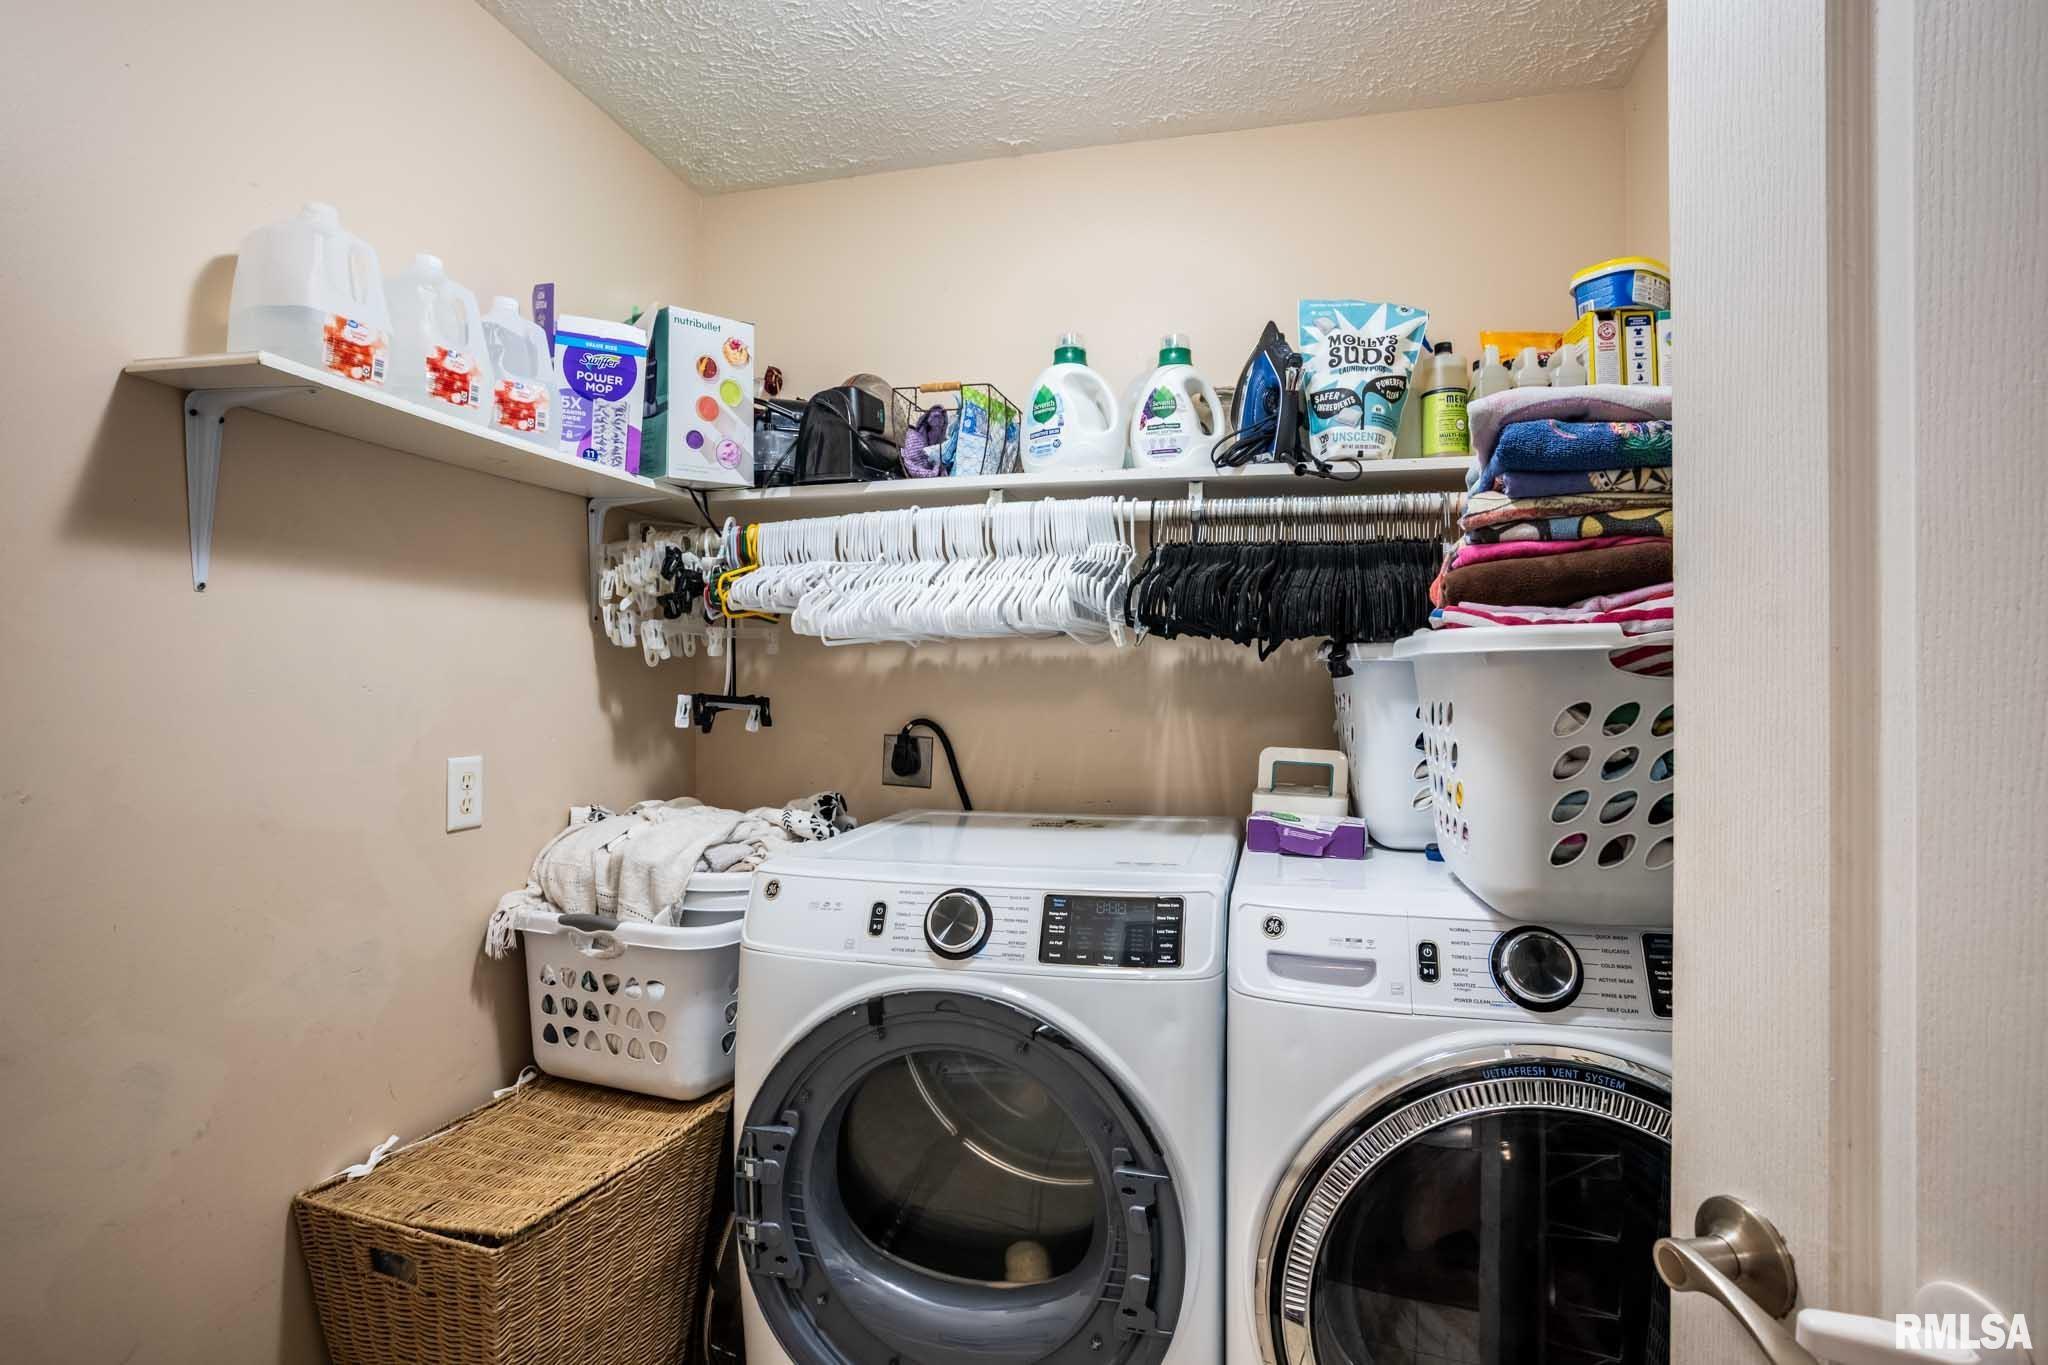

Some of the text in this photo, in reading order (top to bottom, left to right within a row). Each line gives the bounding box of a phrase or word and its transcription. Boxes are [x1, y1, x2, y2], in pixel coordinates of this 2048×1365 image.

[674, 315, 721, 333] nutribullet
[1328, 334, 1399, 348] MOLLY'S
[579, 352, 620, 370] Swiffer
[1328, 345, 1397, 368] SUDS
[576, 370, 624, 386] POWER
[585, 382, 614, 394] MOP
[561, 396, 582, 410] 5X
[1313, 391, 1340, 404] SAFER
[1316, 396, 1356, 412] INGREDIENTS
[1332, 431, 1386, 445] UNSCENTED
[586, 449, 596, 458] 11
[1482, 1065, 1626, 1091] ULTRAFRESH VENT SYSTEM
